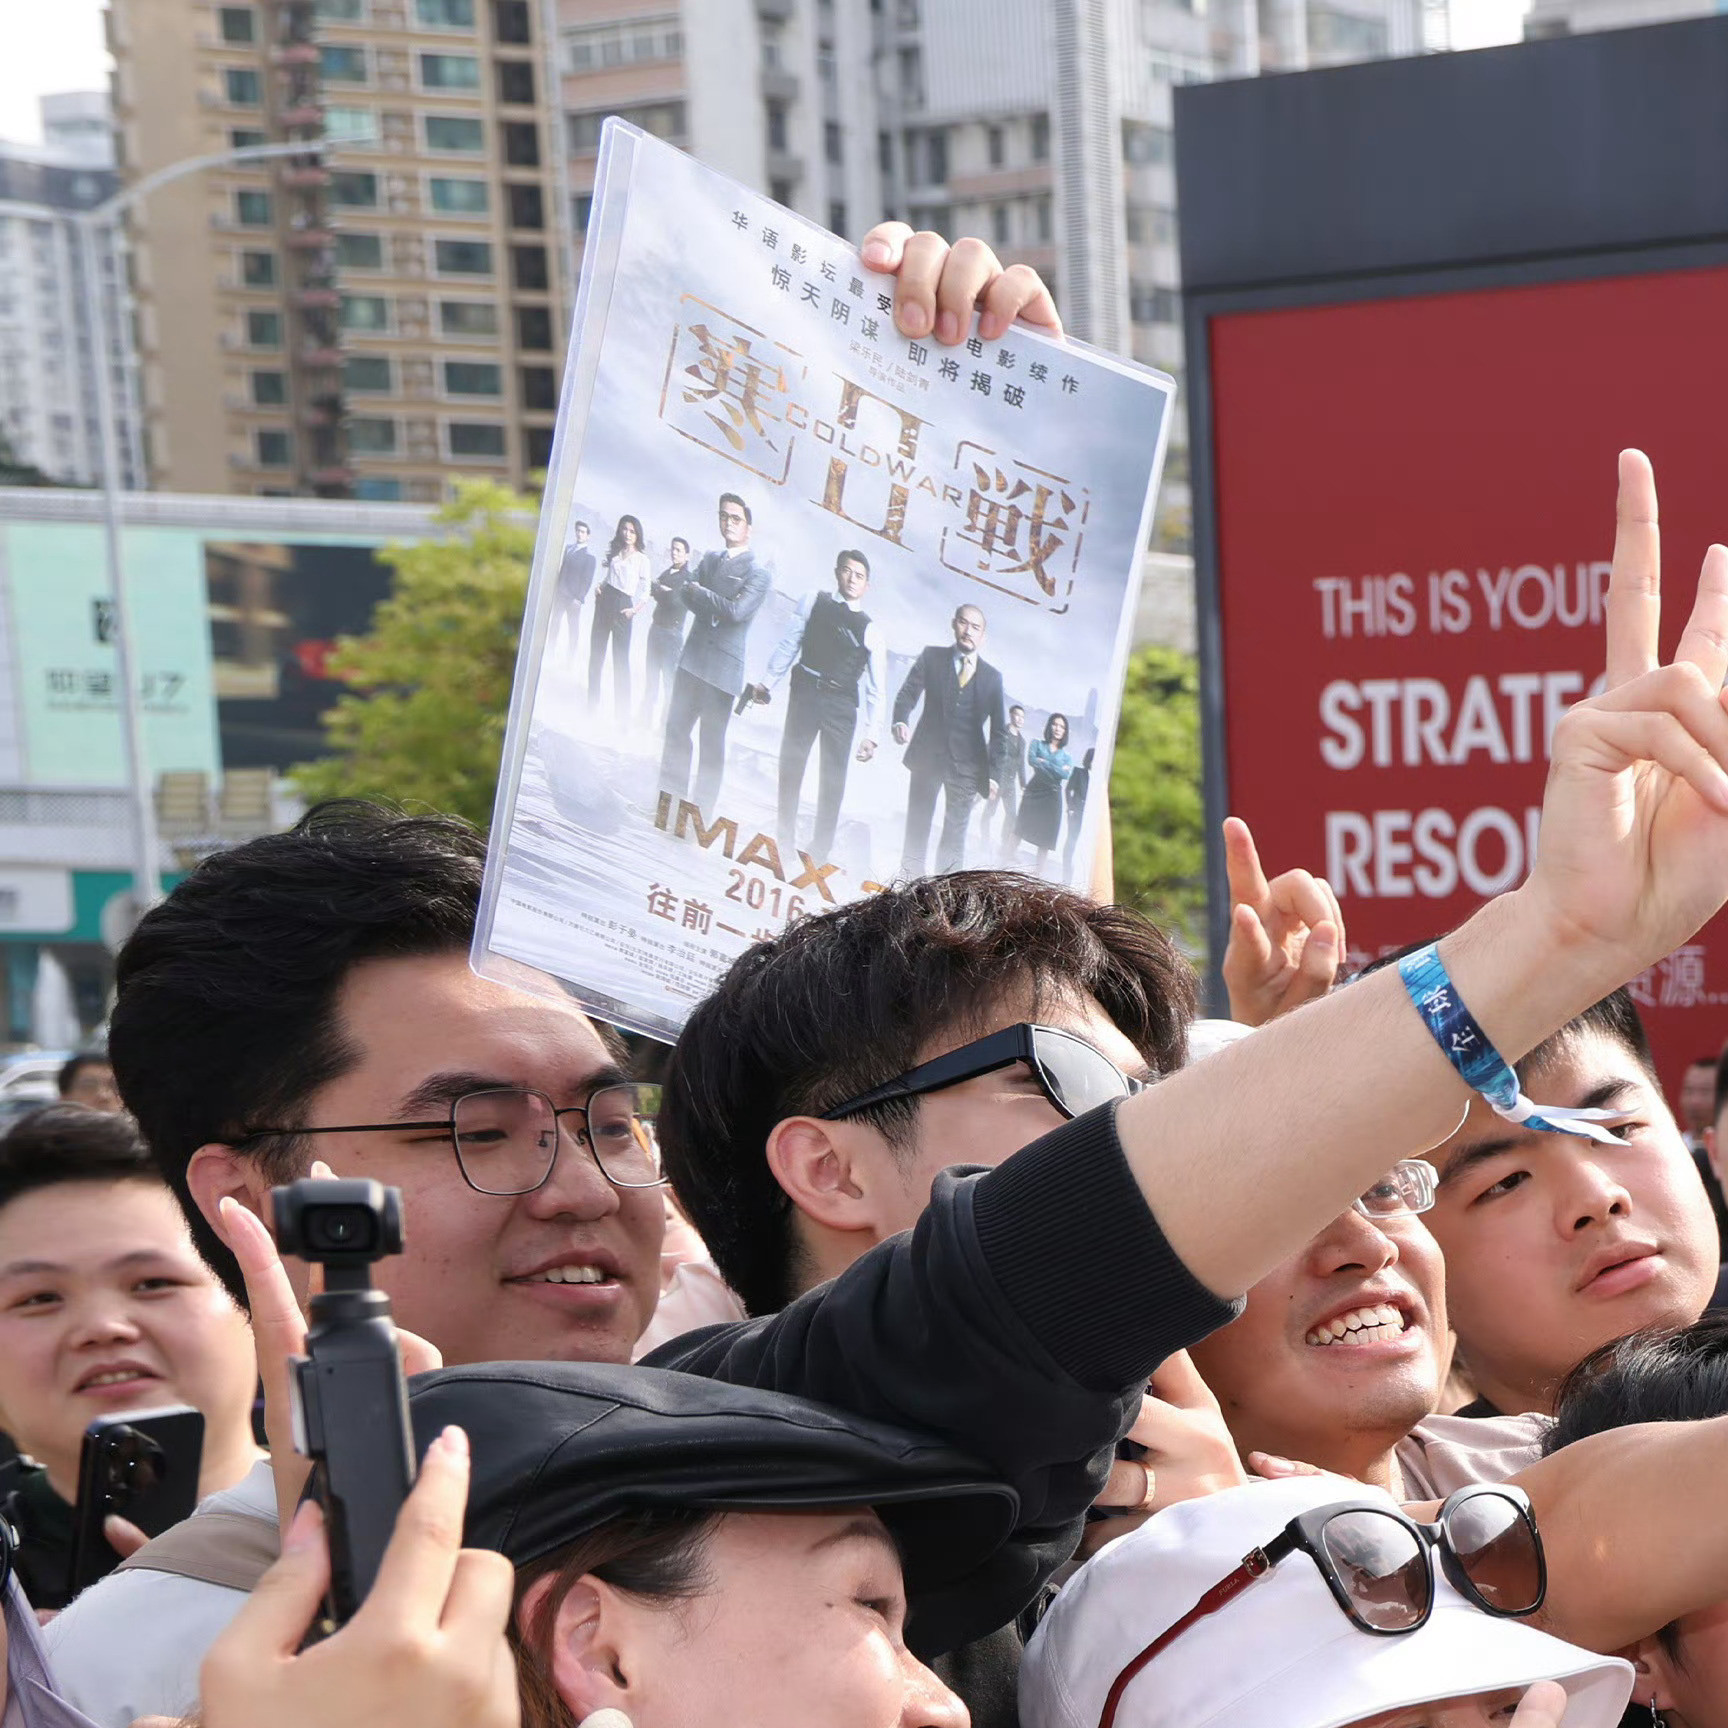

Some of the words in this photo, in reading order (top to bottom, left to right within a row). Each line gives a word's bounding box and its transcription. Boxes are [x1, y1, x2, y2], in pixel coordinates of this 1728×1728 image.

[731, 210, 1080, 395] 华语影坛最受电影续作
[771, 263, 880, 343] 惊天阴谋
[908, 341, 1027, 410] 即将揭破
[683, 324, 790, 453] 寒
[1314, 571, 1416, 639] THIS
[1429, 569, 1473, 634] IS
[654, 790, 837, 904] IMAX
[725, 868, 806, 922] 2016
